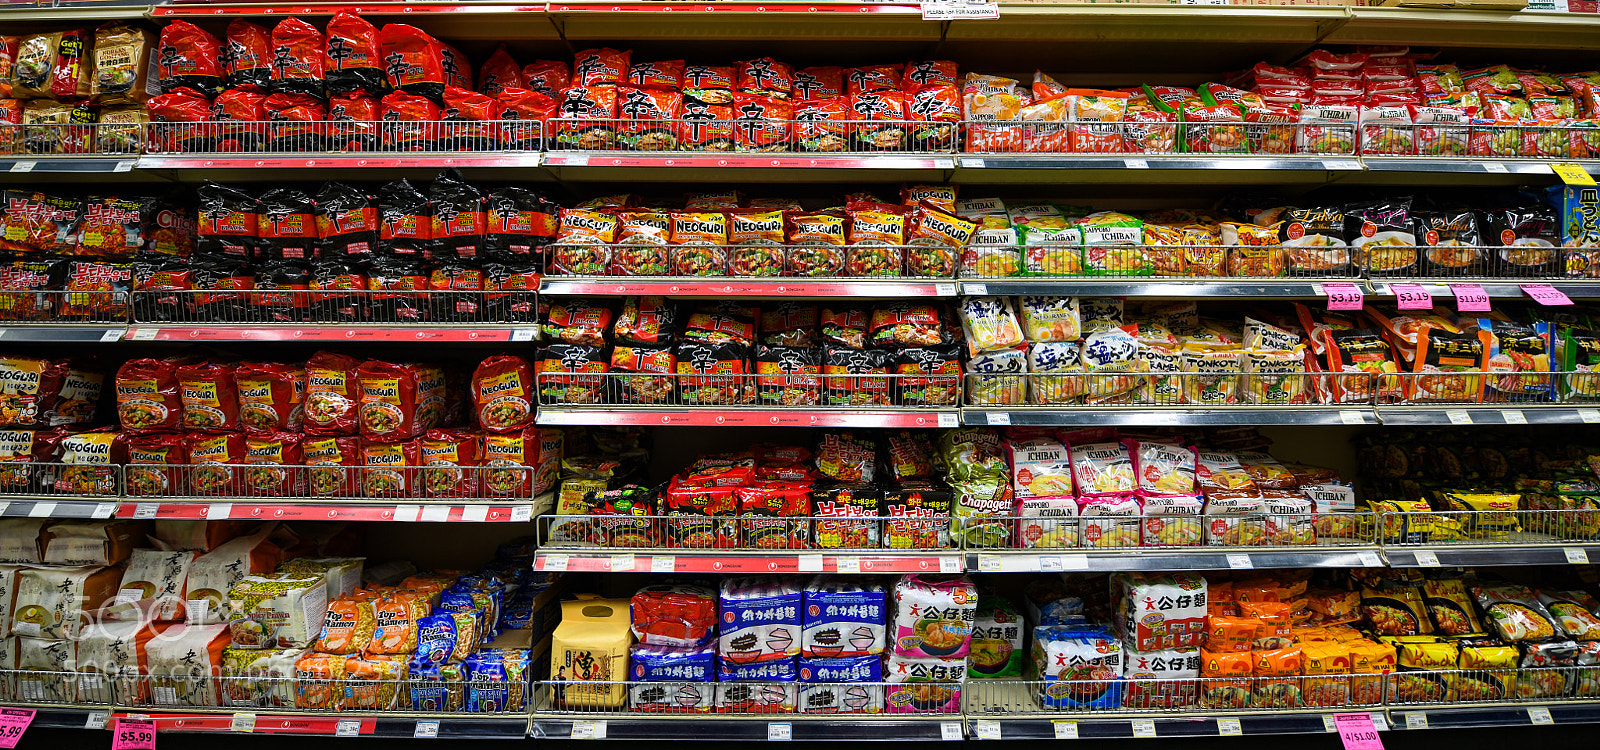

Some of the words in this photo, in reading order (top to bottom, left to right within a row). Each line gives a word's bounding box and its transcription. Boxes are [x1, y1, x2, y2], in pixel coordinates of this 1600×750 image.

[103, 47, 126, 56] KOREAN
[273, 45, 296, 81] 辛
[578, 54, 604, 86] 辛
[631, 62, 661, 85] 辛
[740, 58, 777, 90] 辛
[685, 65, 716, 87] 辛
[793, 71, 824, 100] 辛
[970, 113, 997, 121] SAPPORO
[1320, 110, 1352, 119] ICHIBAN
[1380, 108, 1408, 118] ICHIBAN
[911, 191, 955, 201] NEOGURI
[5, 199, 75, 221] 불닭볶음면
[964, 202, 996, 210] ICHIBAN
[84, 204, 140, 227] 불닭볶음면
[206, 201, 230, 233] 辛
[268, 202, 292, 235] 辛
[326, 200, 349, 234] 辛
[434, 201, 458, 235] 辛
[493, 199, 519, 232] 辛
[383, 209, 404, 237] 辛
[734, 221, 781, 232] NEOGURI
[853, 222, 901, 233] NEOGURI
[676, 224, 724, 234] NEOGURI
[923, 217, 970, 242] NEOGURI
[975, 235, 1009, 244] ICHIBAN
[71, 263, 131, 287] 불닭볶음면
[1331, 293, 1361, 303] $3.19
[1399, 292, 1429, 303] $3.19
[1459, 295, 1487, 303] $11.99
[1262, 336, 1294, 350] RAMEN
[1433, 342, 1483, 354] 中華三昧
[561, 347, 590, 383] 辛
[691, 347, 718, 384] 辛
[775, 350, 798, 384] 辛
[1149, 361, 1181, 371] RAMEN
[66, 379, 100, 390] NEOGURI
[309, 377, 344, 386] NEOGURI
[863, 380, 886, 388] BLACK
[363, 387, 397, 397] NEOGURI
[481, 381, 520, 394] NEOGURI
[239, 388, 270, 398] NEOGURI
[951, 432, 999, 446] Chapagetti
[63, 442, 110, 453] NEOGURI
[247, 447, 282, 456] NEOGURI
[487, 445, 522, 454] NEOGURI
[130, 452, 166, 461] NEOGURI
[1028, 452, 1060, 460] ICHIBAN
[1086, 449, 1121, 459] ICHIBAN
[1157, 452, 1189, 462] ICHIBAN
[1200, 454, 1233, 462] ICHIBAN
[366, 455, 402, 464] NEOGURI
[1315, 492, 1346, 501] ICHIBAN
[692, 498, 708, 506] Spicy
[767, 500, 782, 509] Spicy
[1040, 509, 1073, 517] ICHIBAN
[1163, 506, 1196, 514] ICHIBAN
[1270, 505, 1306, 515] ICHIBAN
[953, 587, 968, 604] 5
[1158, 595, 1206, 611] 公仔麵
[247, 612, 264, 620] Spicy
[326, 611, 343, 620] Top
[378, 611, 396, 619] Top
[923, 606, 975, 621] 公仔麵
[323, 619, 356, 627] Ramen
[377, 619, 409, 627] Ramen
[421, 628, 440, 636] Top
[971, 627, 1018, 640] 公仔麵
[1151, 658, 1201, 672] 公仔麵
[470, 671, 490, 681] Top
[911, 662, 966, 680] 公仔麵
[120, 731, 152, 743] $5.99
[1345, 731, 1376, 742] 4/$1.00
